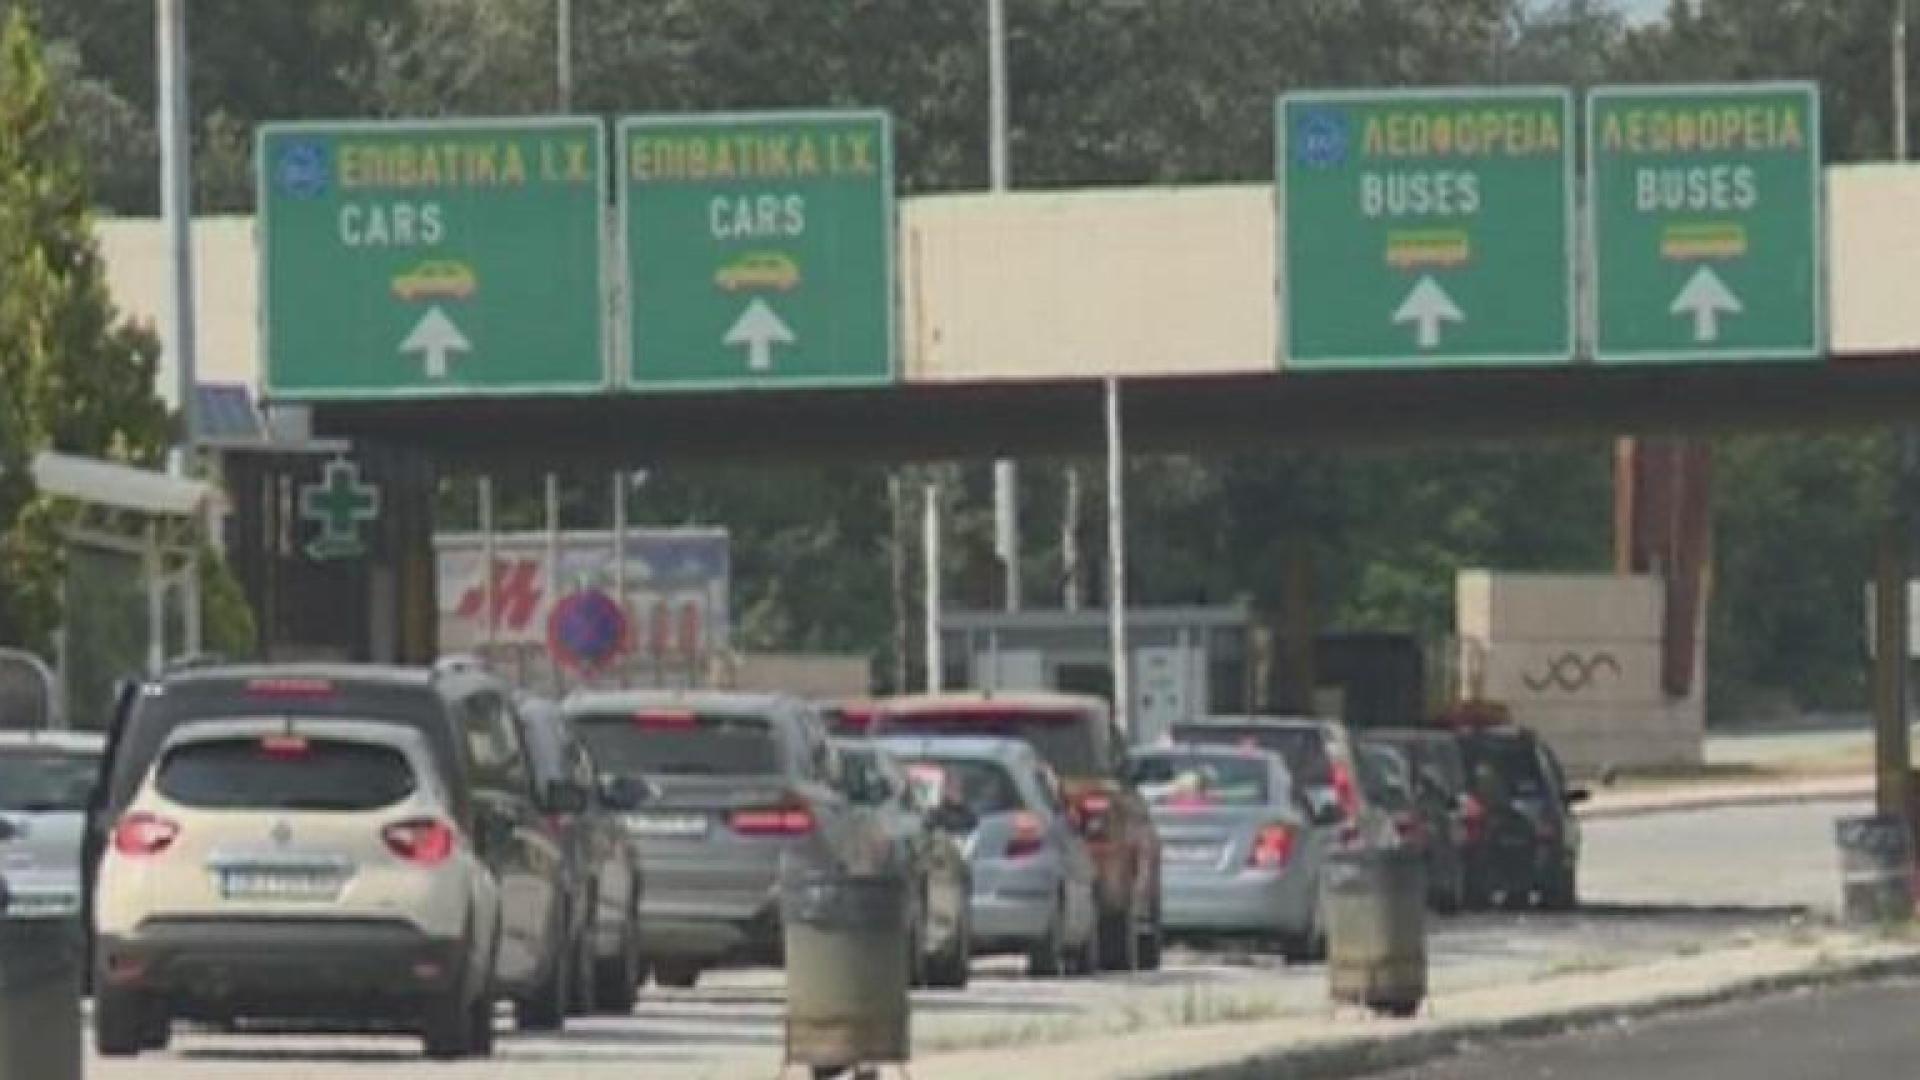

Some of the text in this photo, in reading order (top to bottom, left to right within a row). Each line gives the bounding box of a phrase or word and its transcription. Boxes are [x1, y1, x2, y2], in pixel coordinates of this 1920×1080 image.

[1361, 170, 1480, 218] BUSES
[1637, 165, 1757, 211] BUSES
[340, 202, 443, 246] CARS
[709, 192, 805, 240] CARS
